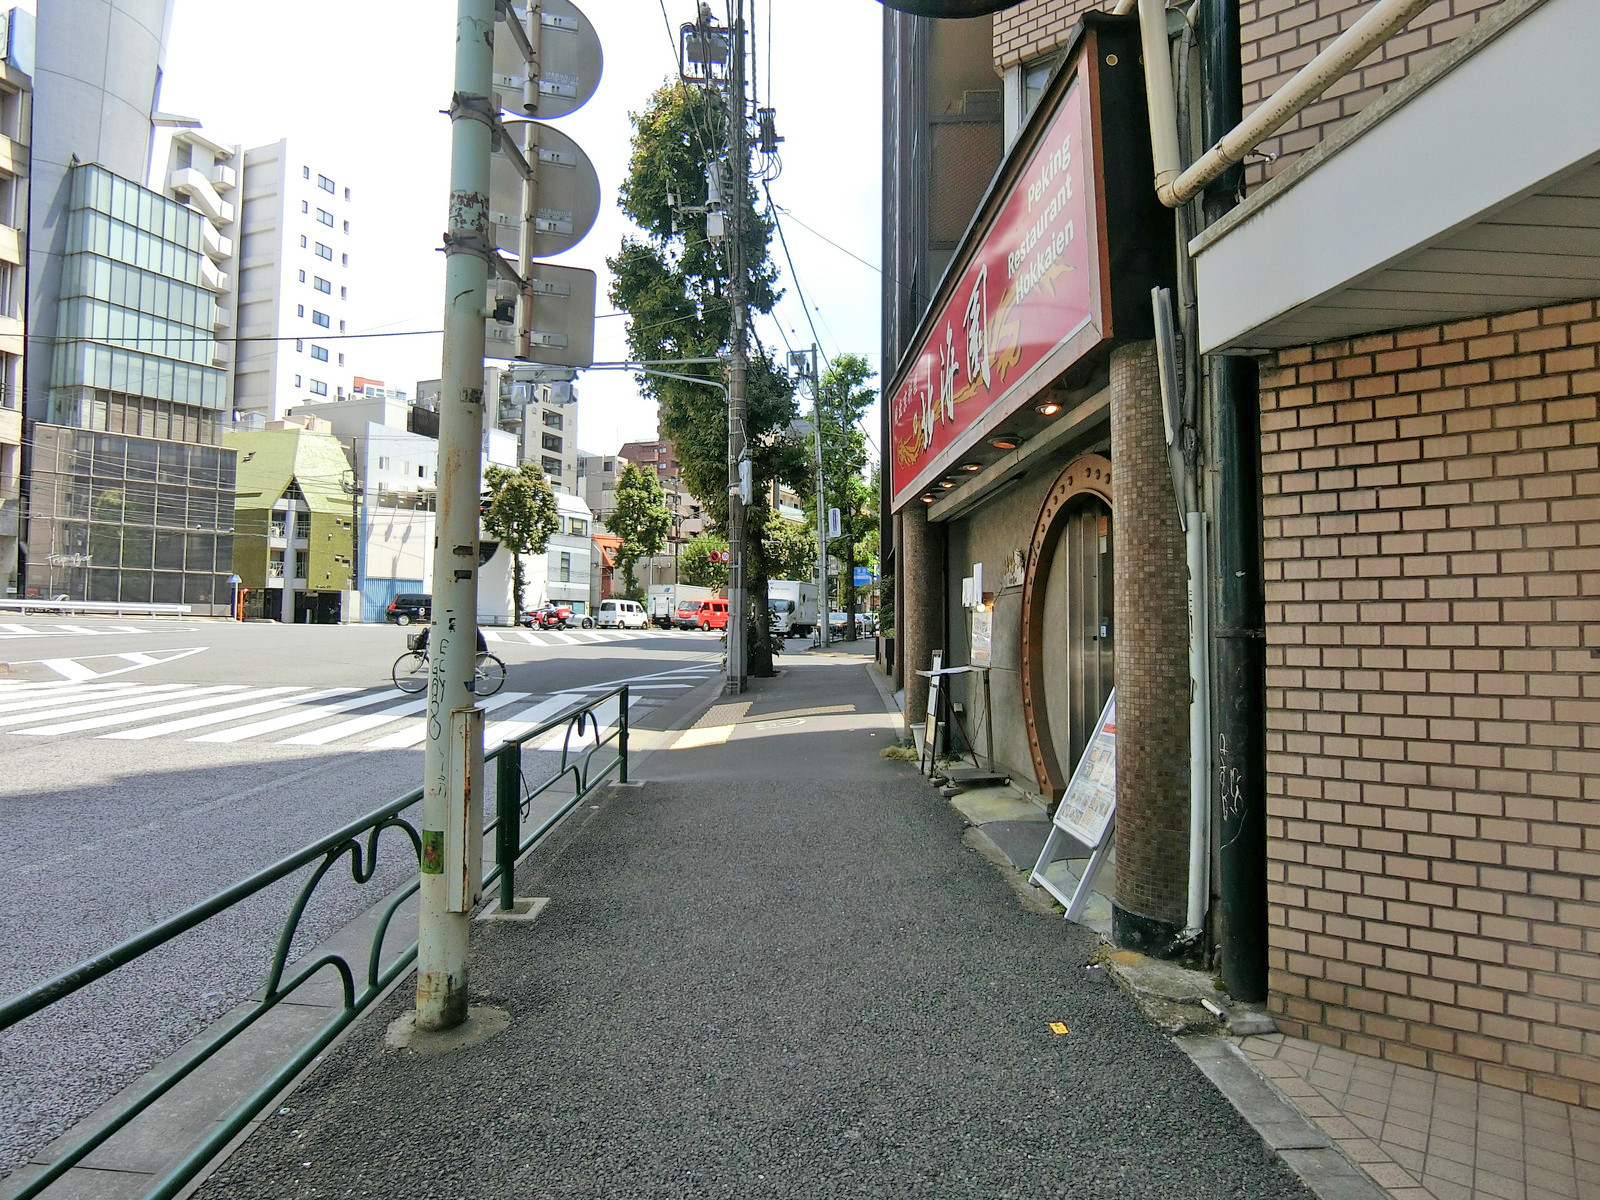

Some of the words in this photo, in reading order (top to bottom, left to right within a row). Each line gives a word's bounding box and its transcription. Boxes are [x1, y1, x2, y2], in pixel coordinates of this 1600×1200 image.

[1027, 132, 1071, 214] Peking
[1008, 171, 1073, 279] Restaurant
[1015, 219, 1075, 305] Hokkaien
